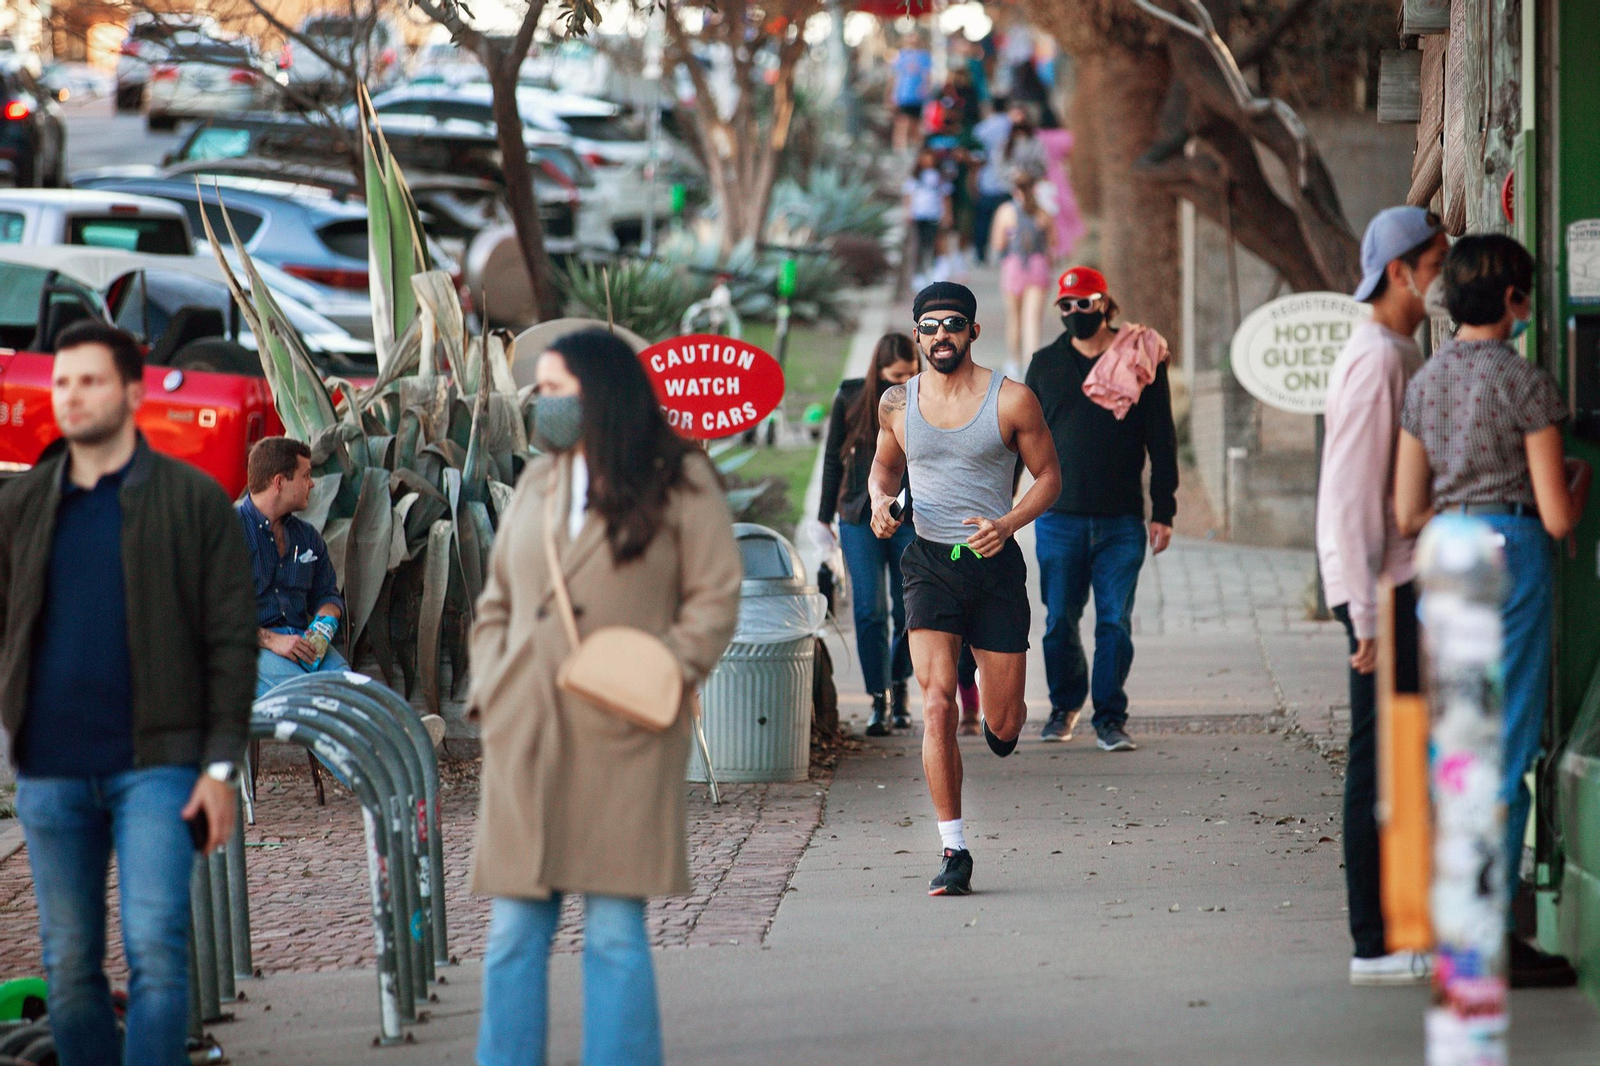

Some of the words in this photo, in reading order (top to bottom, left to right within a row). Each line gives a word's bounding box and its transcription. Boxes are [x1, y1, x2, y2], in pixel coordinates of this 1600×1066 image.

[650, 343, 755, 373] CAUTION
[1264, 346, 1342, 367] GUES
[664, 376, 740, 397] WATCH
[1284, 371, 1328, 391] ON
[701, 401, 757, 430] CARS
